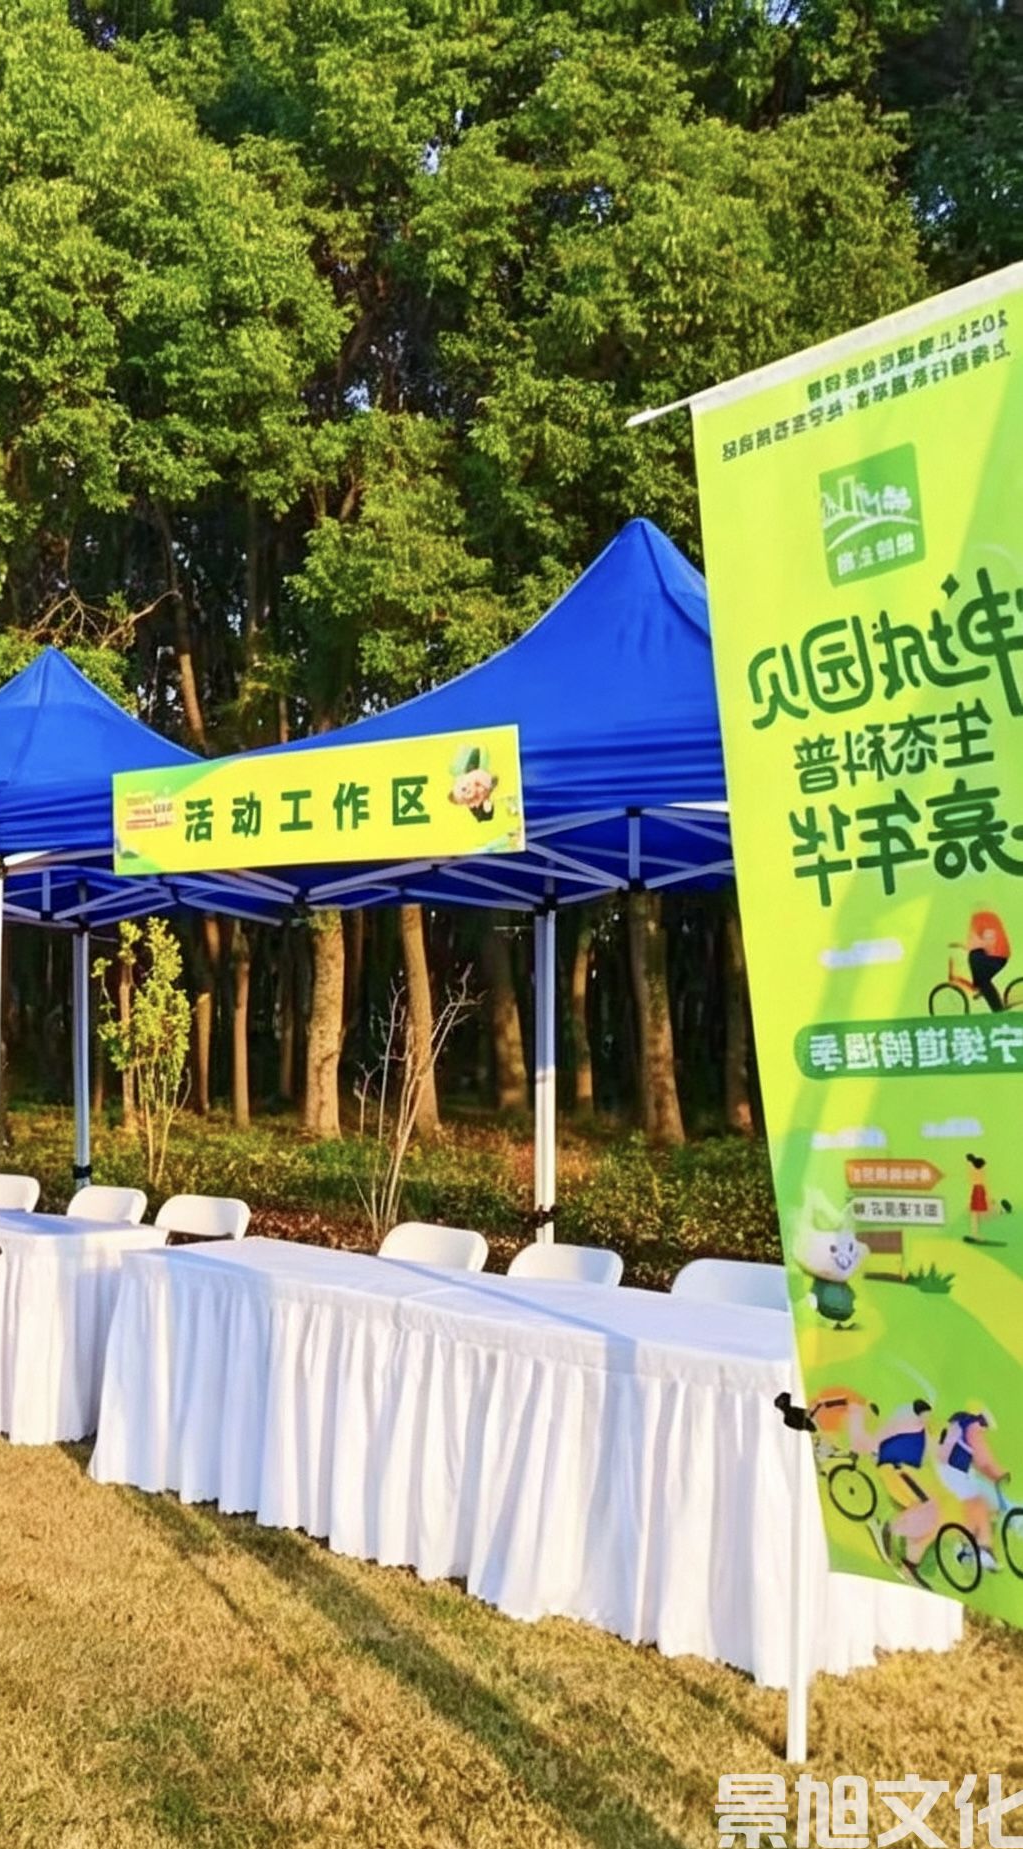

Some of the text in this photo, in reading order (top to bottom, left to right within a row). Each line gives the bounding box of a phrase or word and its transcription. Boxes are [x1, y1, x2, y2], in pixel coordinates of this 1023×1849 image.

[184, 775, 431, 842] 活动工作区
